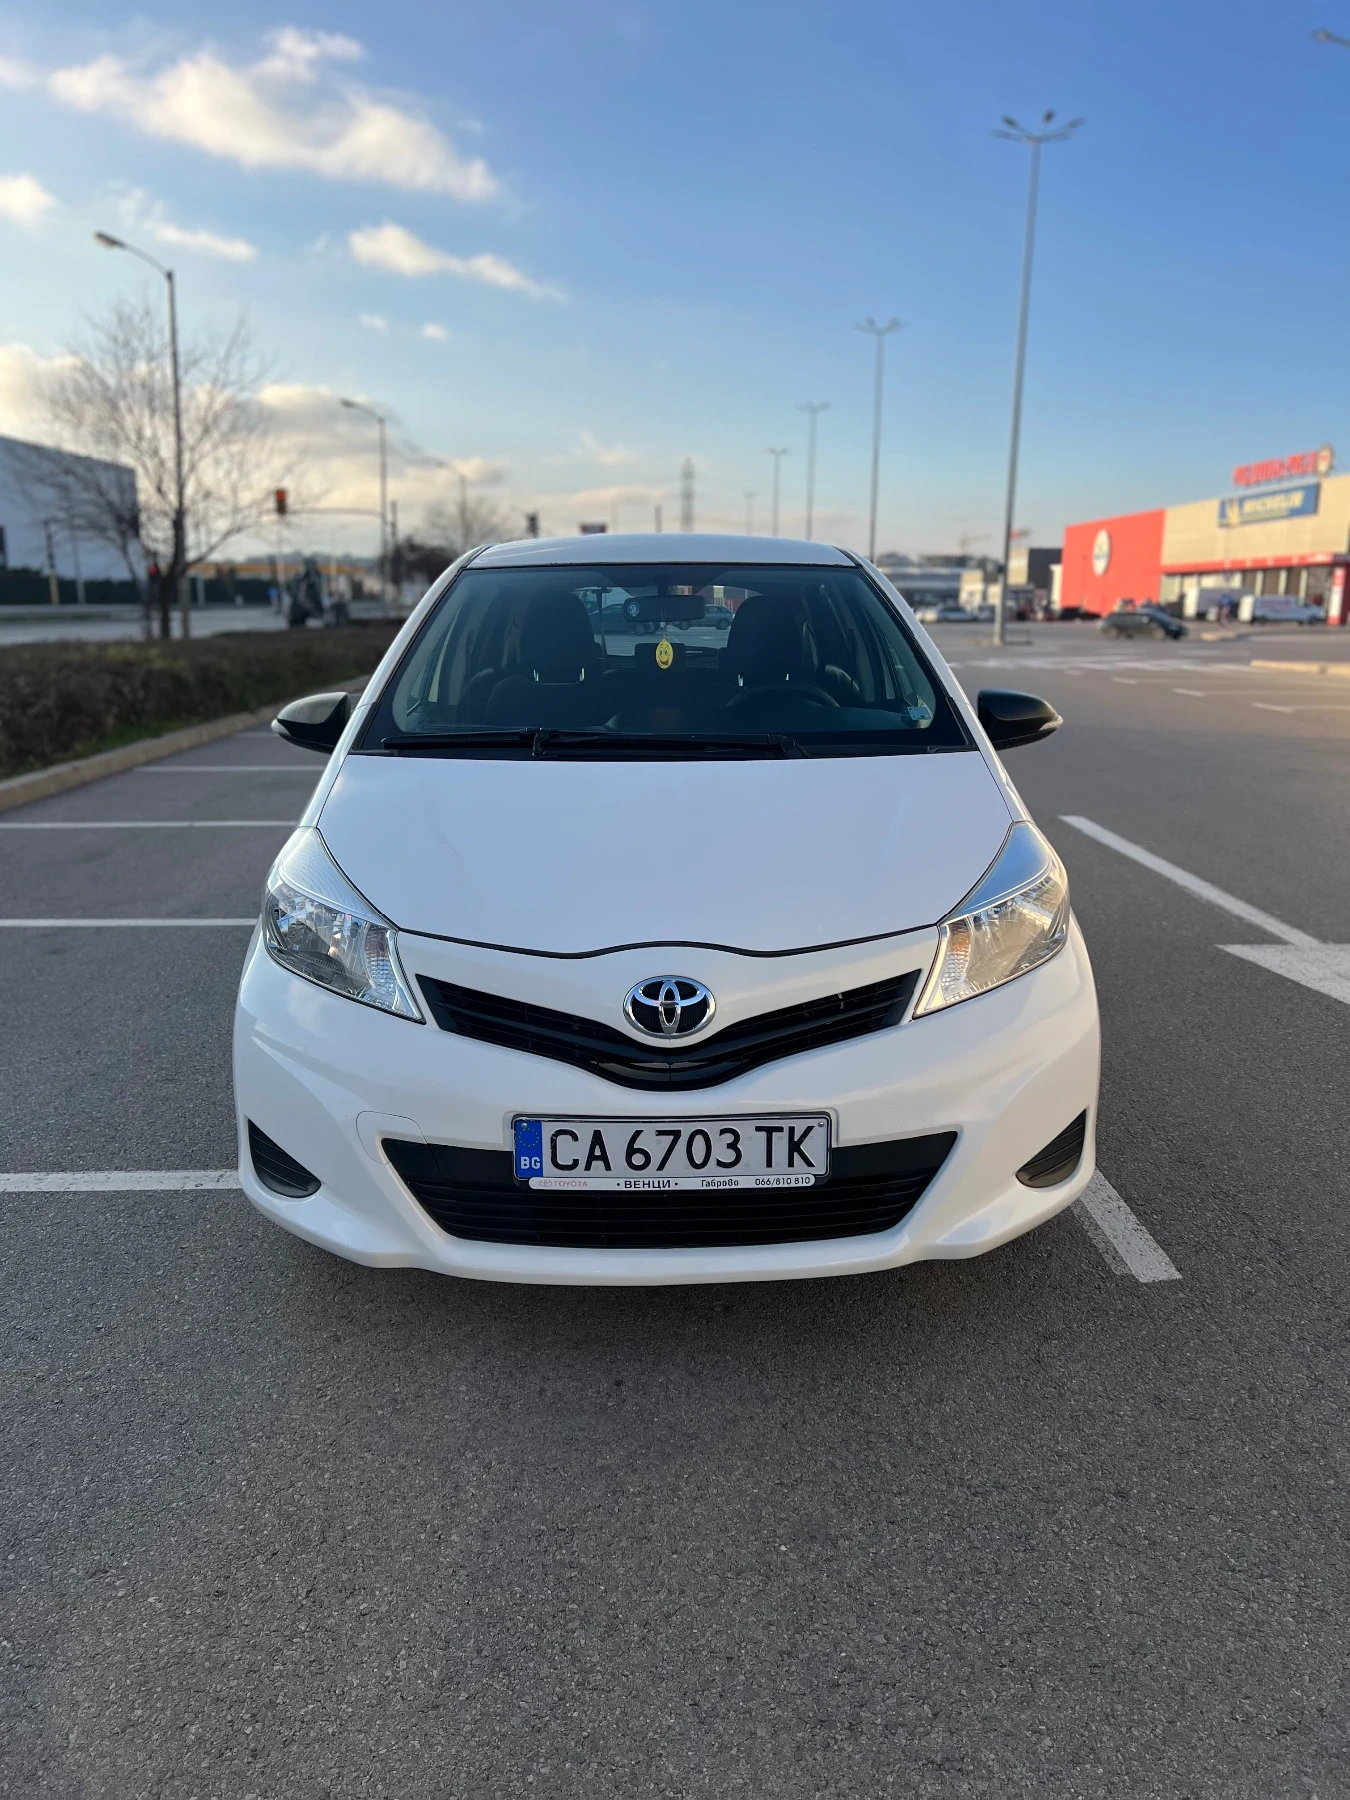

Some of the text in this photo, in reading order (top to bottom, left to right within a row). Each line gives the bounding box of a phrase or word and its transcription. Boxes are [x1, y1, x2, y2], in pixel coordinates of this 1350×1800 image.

[551, 1125, 816, 1171] CA 6703 TK
[520, 1157, 541, 1169] BG
[624, 1177, 811, 1190] ВЕНЦИ Габрово 066/810 810
